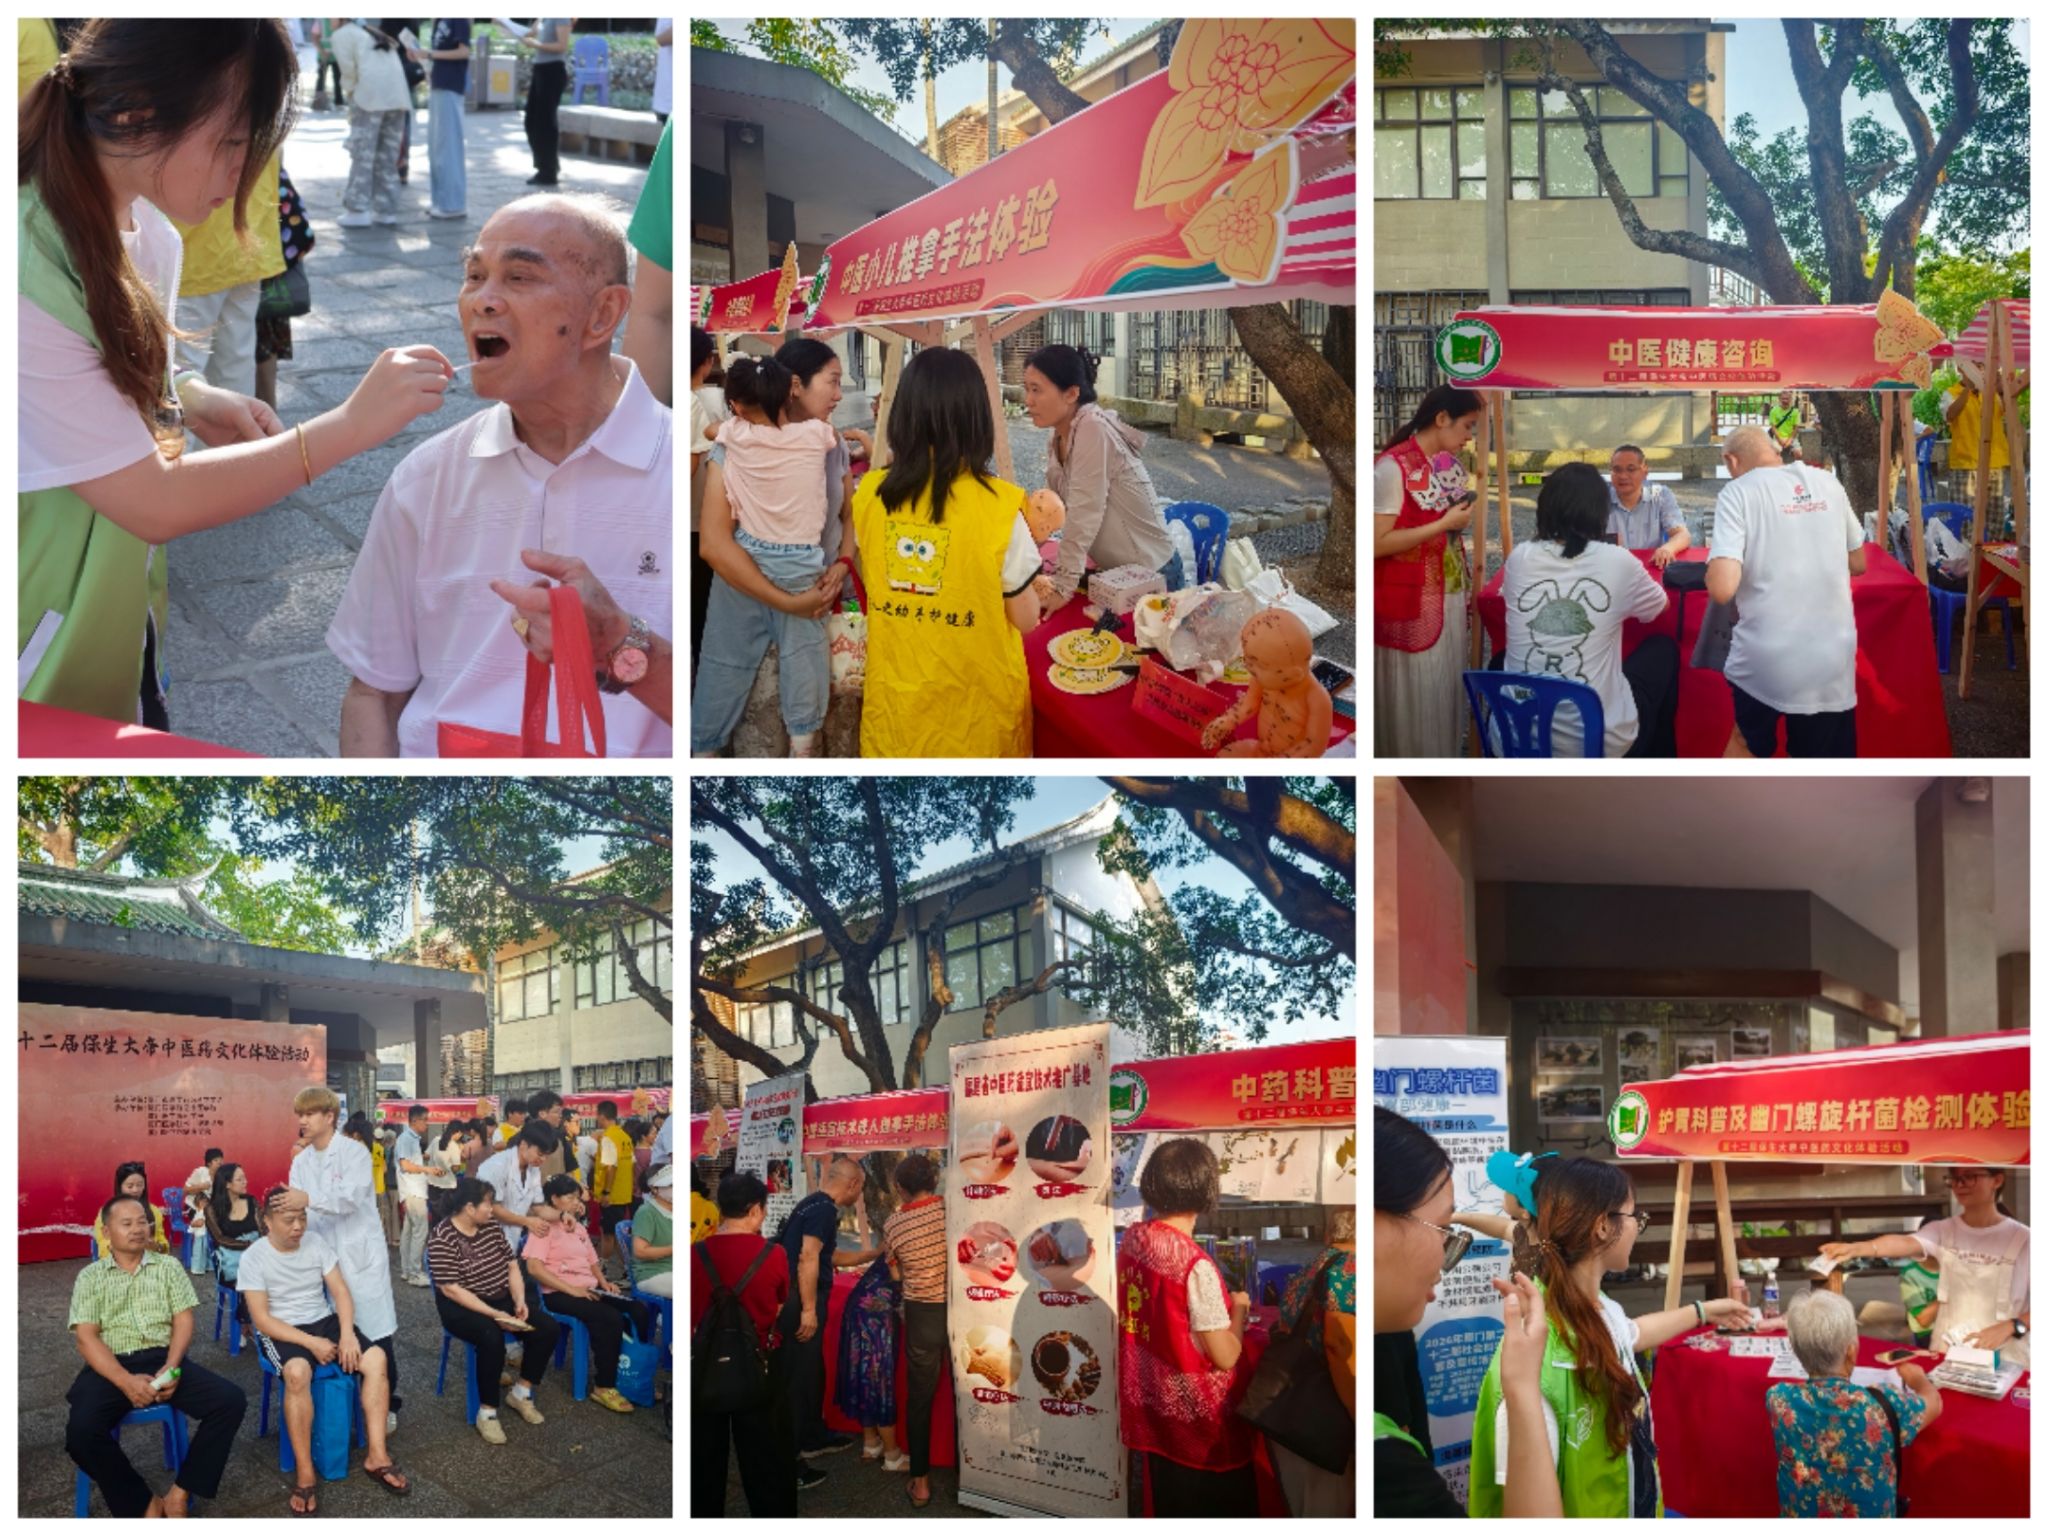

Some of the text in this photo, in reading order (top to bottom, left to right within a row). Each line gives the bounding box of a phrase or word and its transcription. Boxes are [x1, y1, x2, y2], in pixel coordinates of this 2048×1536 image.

[1608, 338, 1774, 368] 中医健康咨询
[1545, 654, 1563, 673] R
[1232, 1066, 1356, 1103] 中药科普
